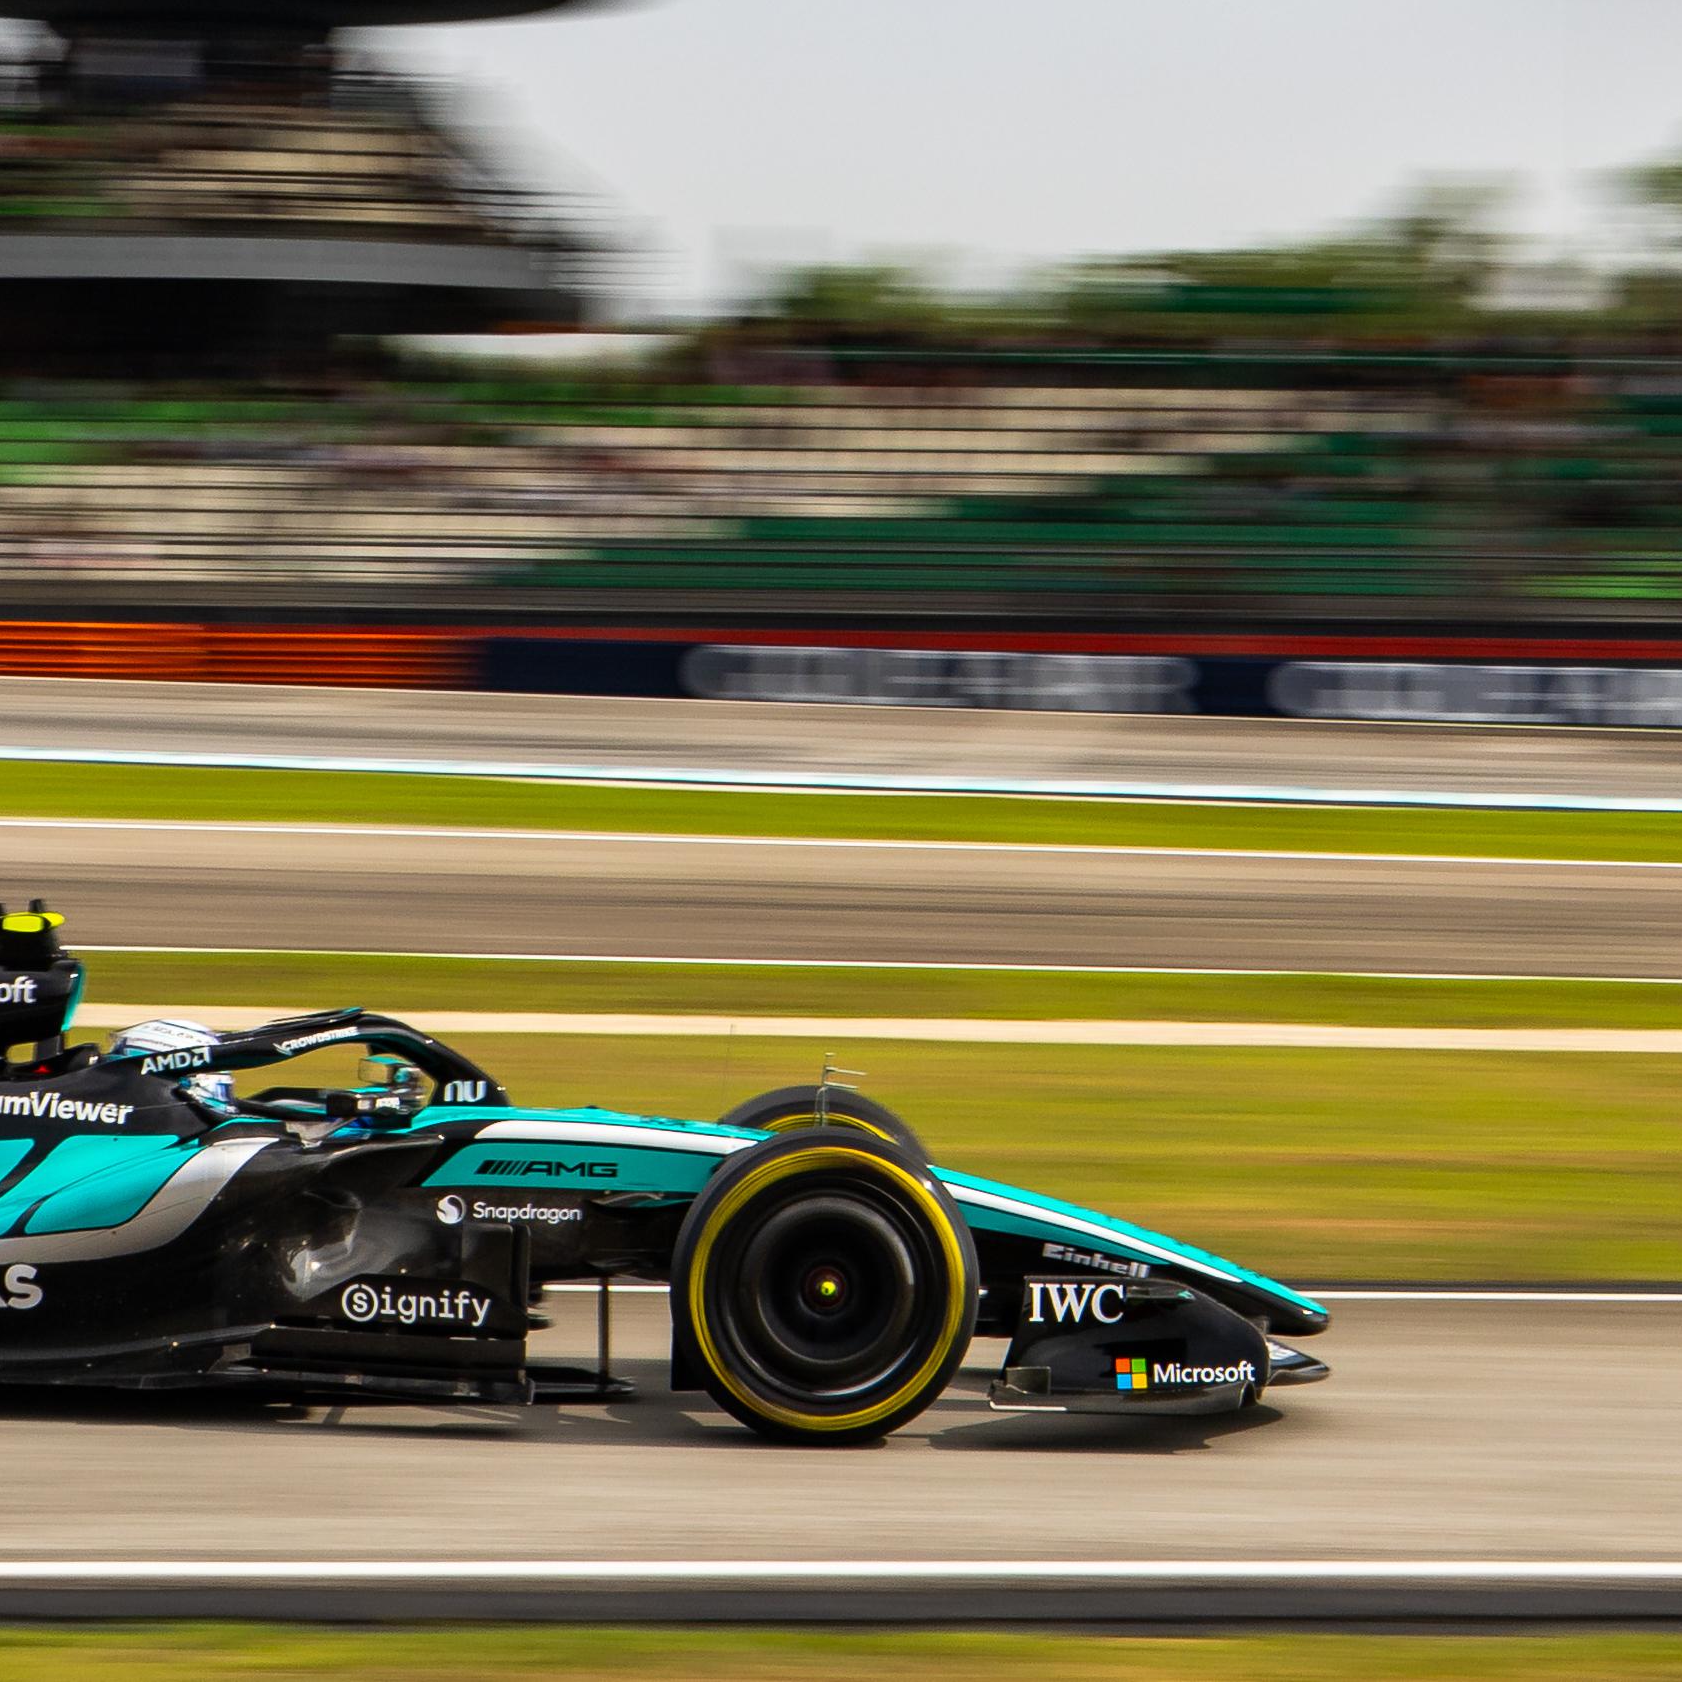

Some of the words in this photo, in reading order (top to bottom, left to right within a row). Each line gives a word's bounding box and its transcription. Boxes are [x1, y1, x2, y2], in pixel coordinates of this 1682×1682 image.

[140, 1051, 193, 1075] AMD
[521, 1160, 618, 1178] AMG
[472, 1201, 583, 1224] Snapdragon
[1042, 1242, 1152, 1279] Einhell
[1028, 1282, 1126, 1324] IWC
[1154, 1360, 1256, 1384] Microsoft
